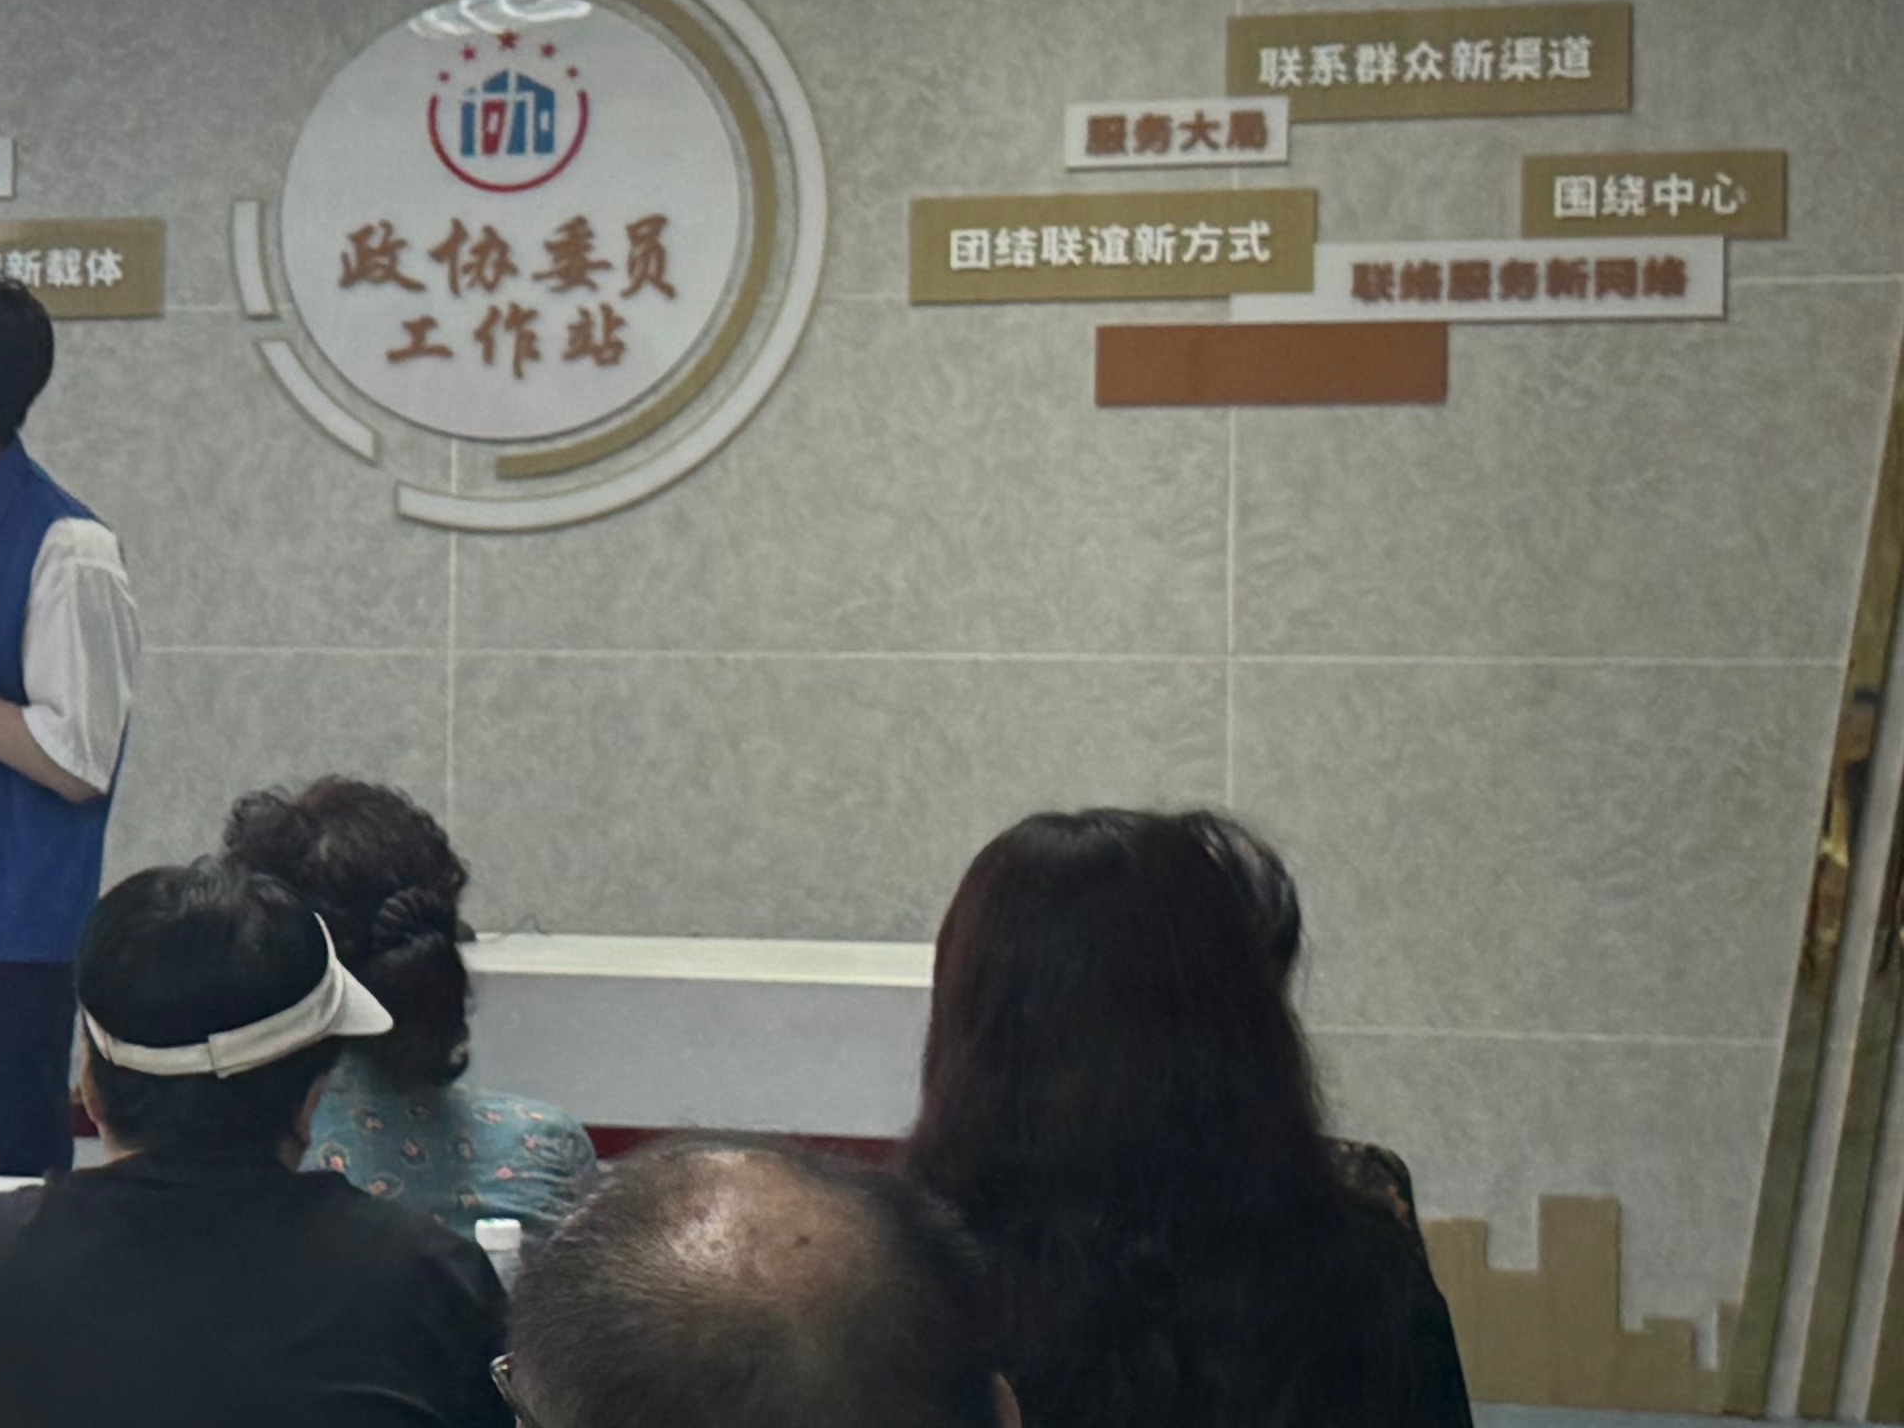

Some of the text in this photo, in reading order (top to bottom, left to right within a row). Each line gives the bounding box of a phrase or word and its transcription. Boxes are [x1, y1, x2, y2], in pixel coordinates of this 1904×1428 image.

[1257, 35, 1593, 89] 联系群众新渠道
[1085, 109, 1269, 157] 服务大局
[1553, 173, 1747, 220] 围绕中心
[337, 213, 678, 301] 政协委员
[948, 220, 1271, 272] 团结联谊新方式
[386, 301, 628, 381] 工作站
